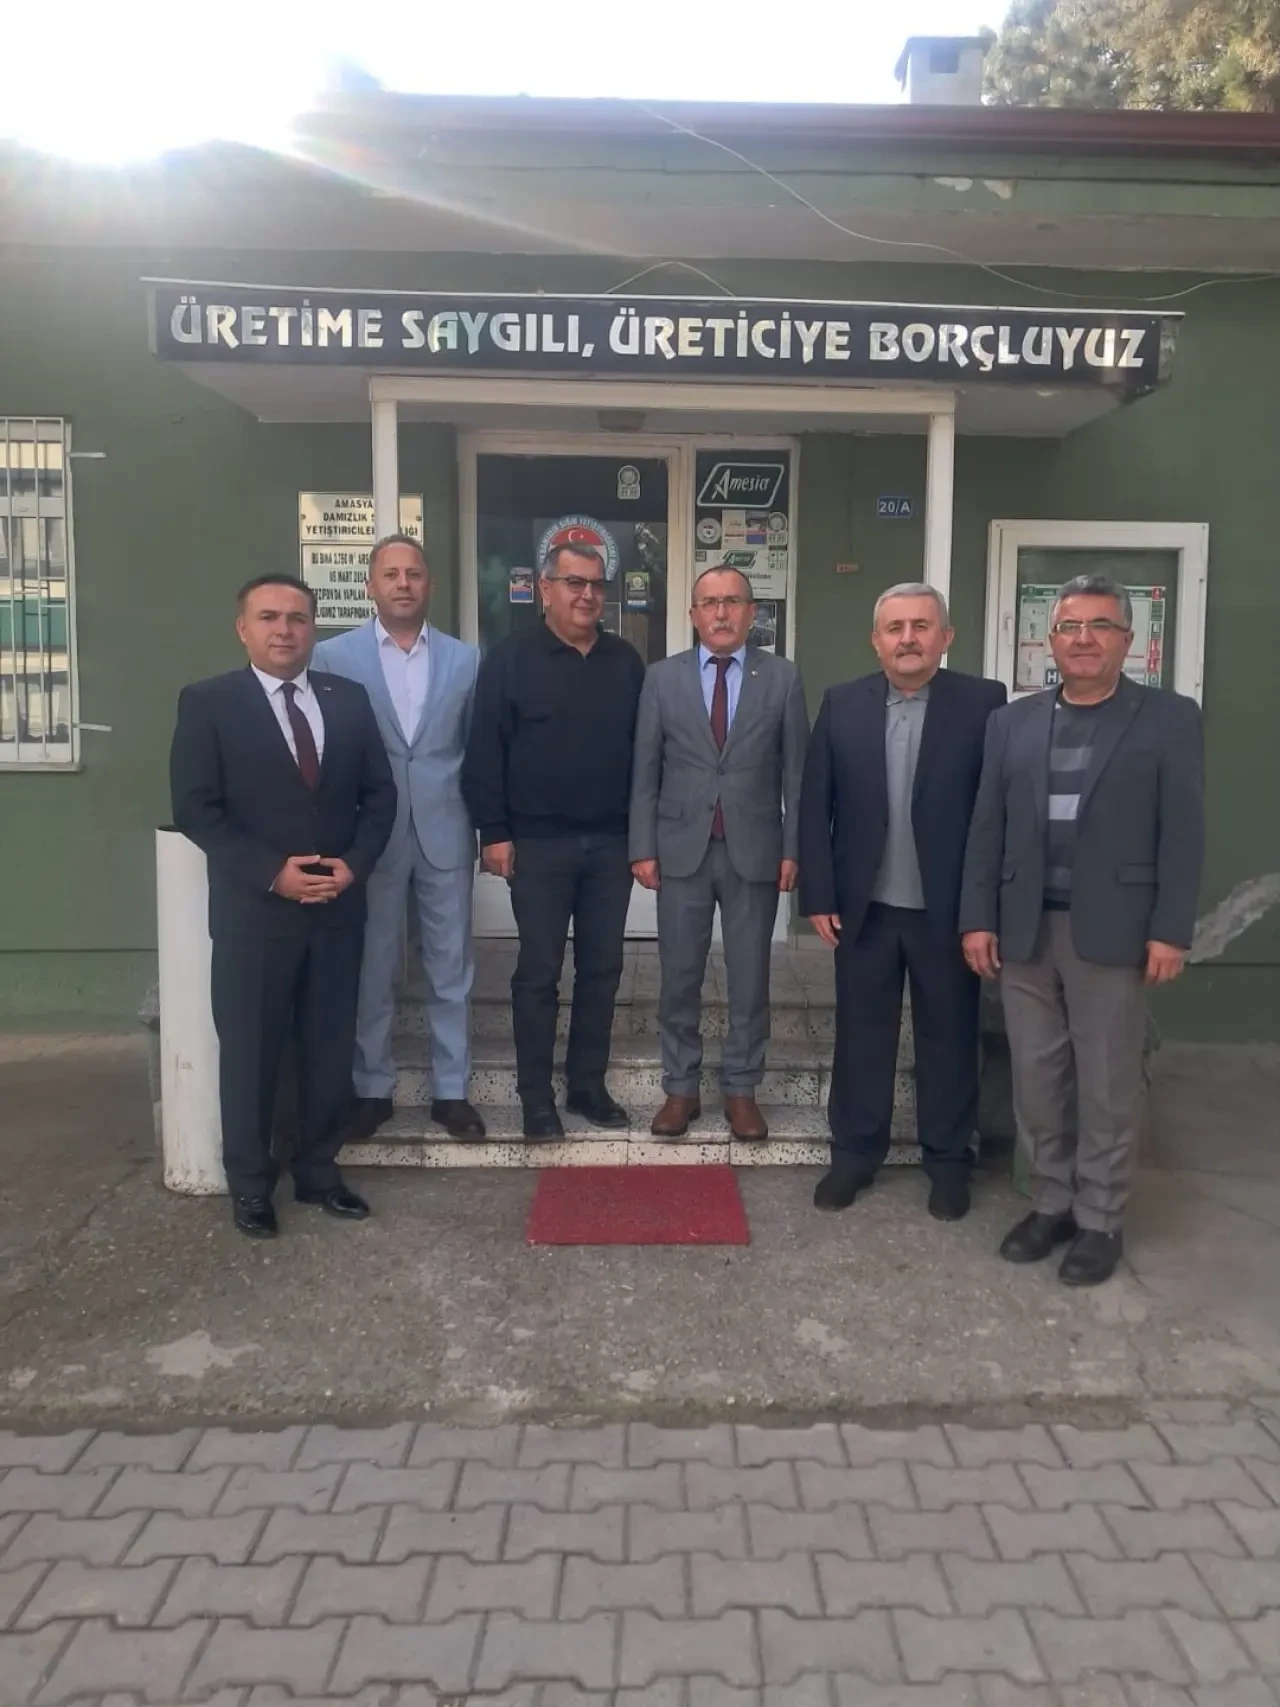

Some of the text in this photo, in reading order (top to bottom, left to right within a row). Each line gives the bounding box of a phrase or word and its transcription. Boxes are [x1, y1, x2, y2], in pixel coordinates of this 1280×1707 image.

[170, 297, 1146, 372] ÜRETİME SAYGILI, ÜRETİCİYE BORÇLUYUZ
[711, 469, 770, 500] Amesia
[335, 499, 373, 508] AMASYA
[879, 498, 911, 514] 20/A
[323, 512, 367, 522] DAMIZLIK
[306, 525, 375, 538] YETİŞTİRİCİLE
